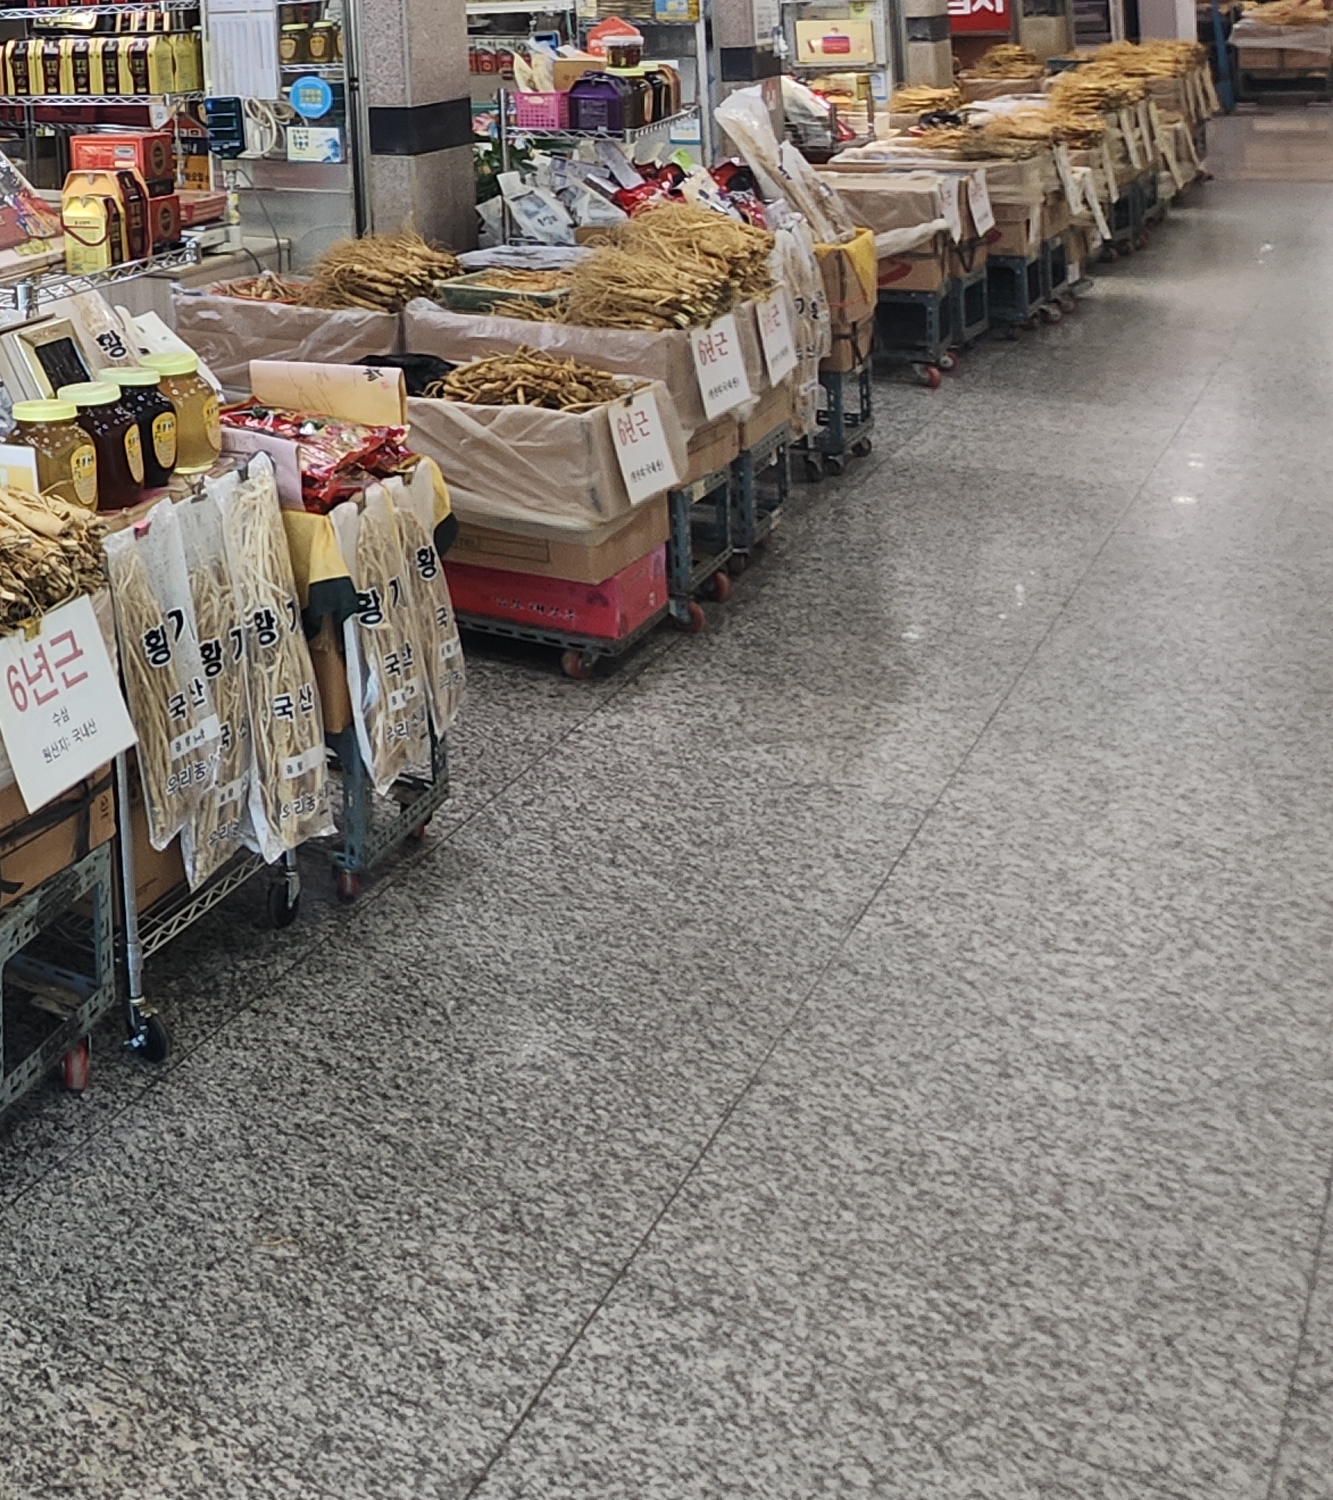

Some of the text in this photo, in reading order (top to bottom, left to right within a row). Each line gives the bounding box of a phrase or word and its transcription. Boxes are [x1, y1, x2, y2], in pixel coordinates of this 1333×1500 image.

[698, 331, 729, 366] 6년근
[617, 410, 651, 447] 6년근
[7, 629, 88, 712] 6년근
[52, 706, 70, 727] 수삼
[72, 718, 98, 743] 국내산
